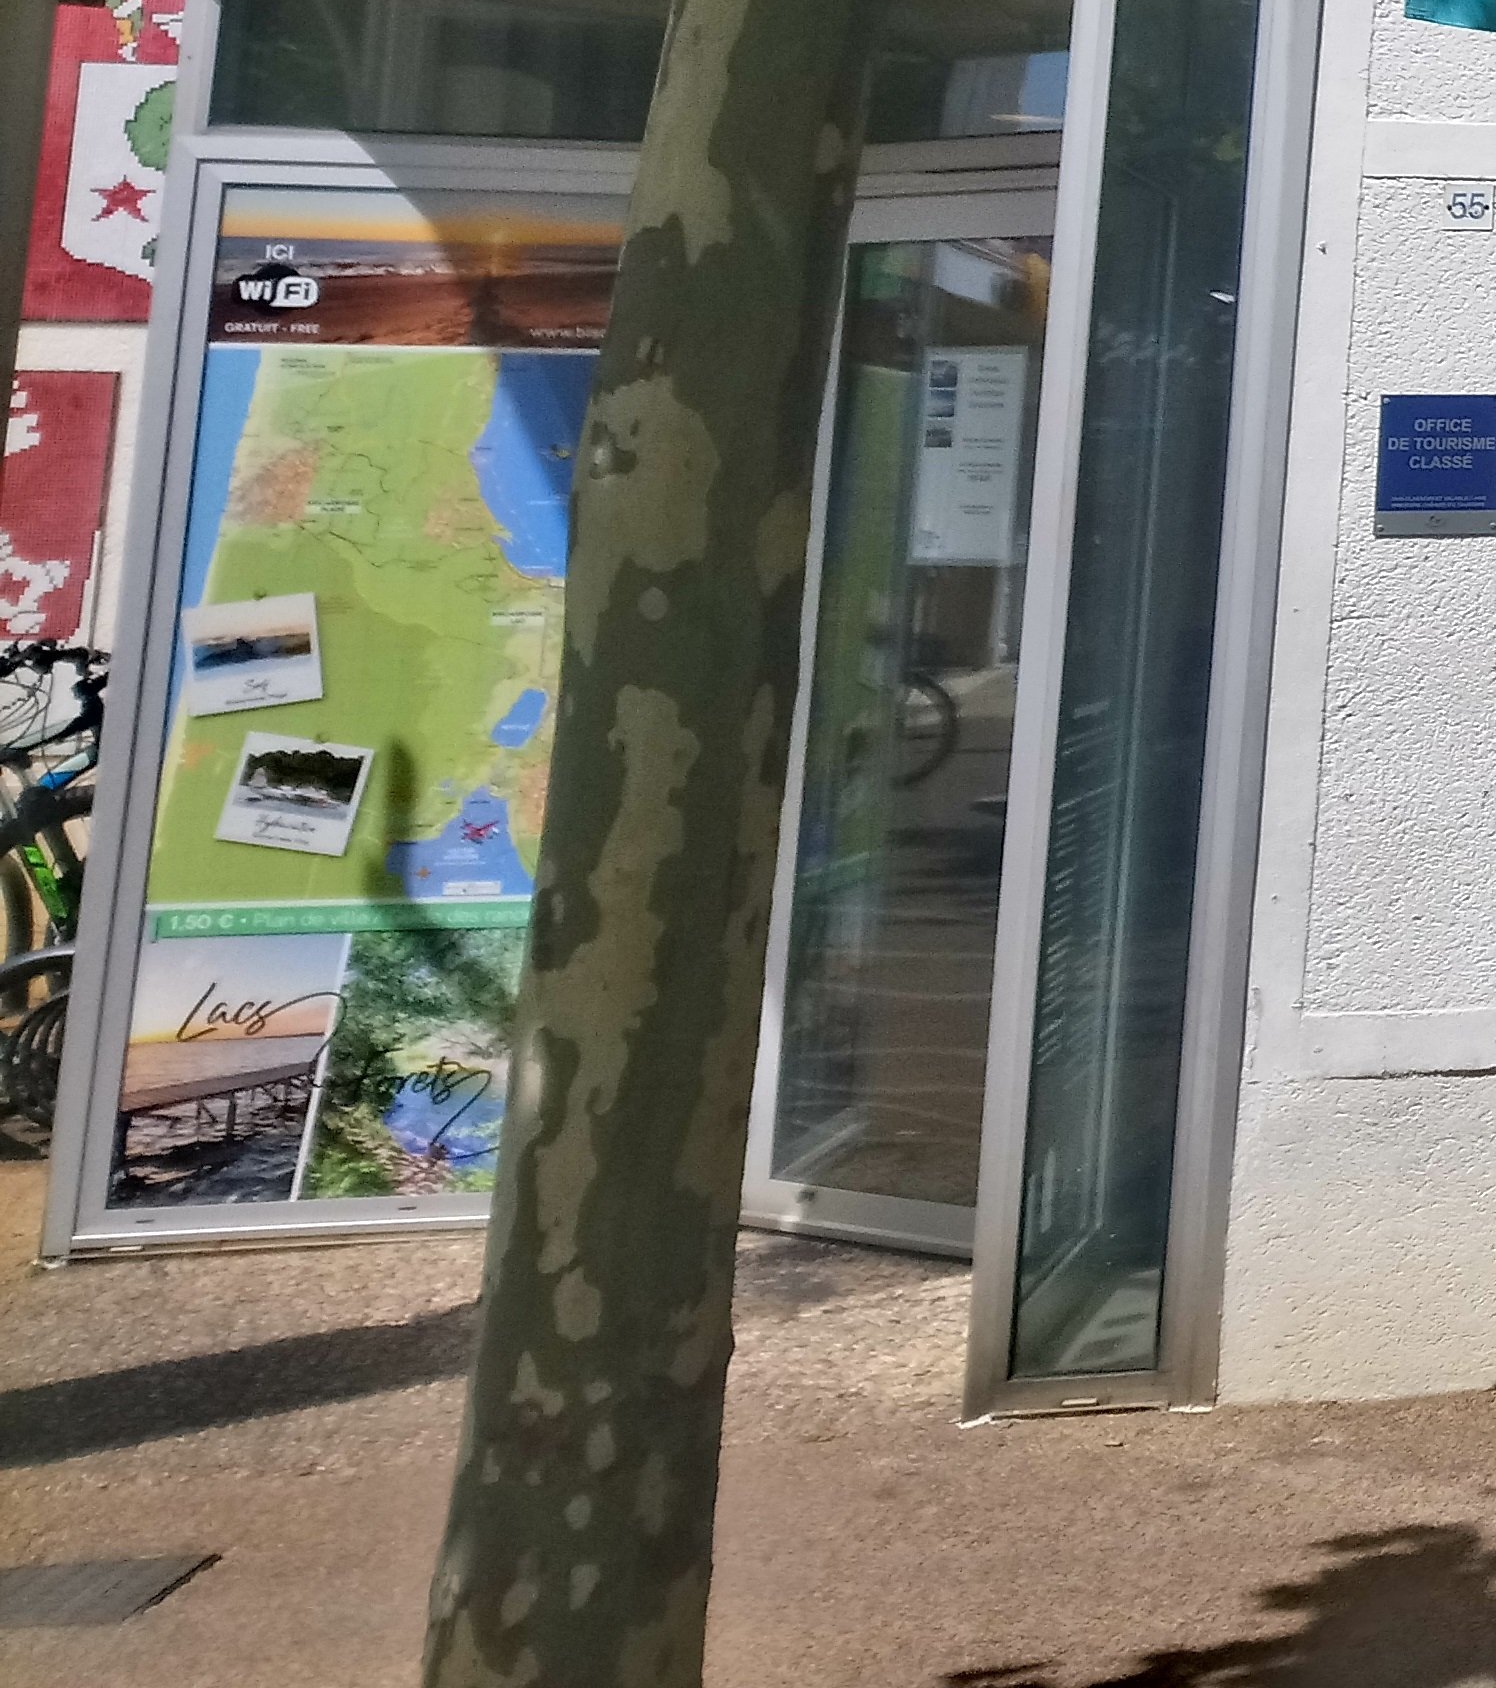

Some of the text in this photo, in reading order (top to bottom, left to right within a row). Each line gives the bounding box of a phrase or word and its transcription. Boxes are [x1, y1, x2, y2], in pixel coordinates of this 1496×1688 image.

[1448, 192, 1487, 220] 55
[265, 244, 294, 260] ICI
[224, 322, 279, 334] GRATUIT
[290, 322, 320, 334] FREE
[1414, 418, 1472, 433] OFFICE
[1387, 437, 1496, 450] DE TOURISME
[1408, 452, 1474, 469] CLASSÉ
